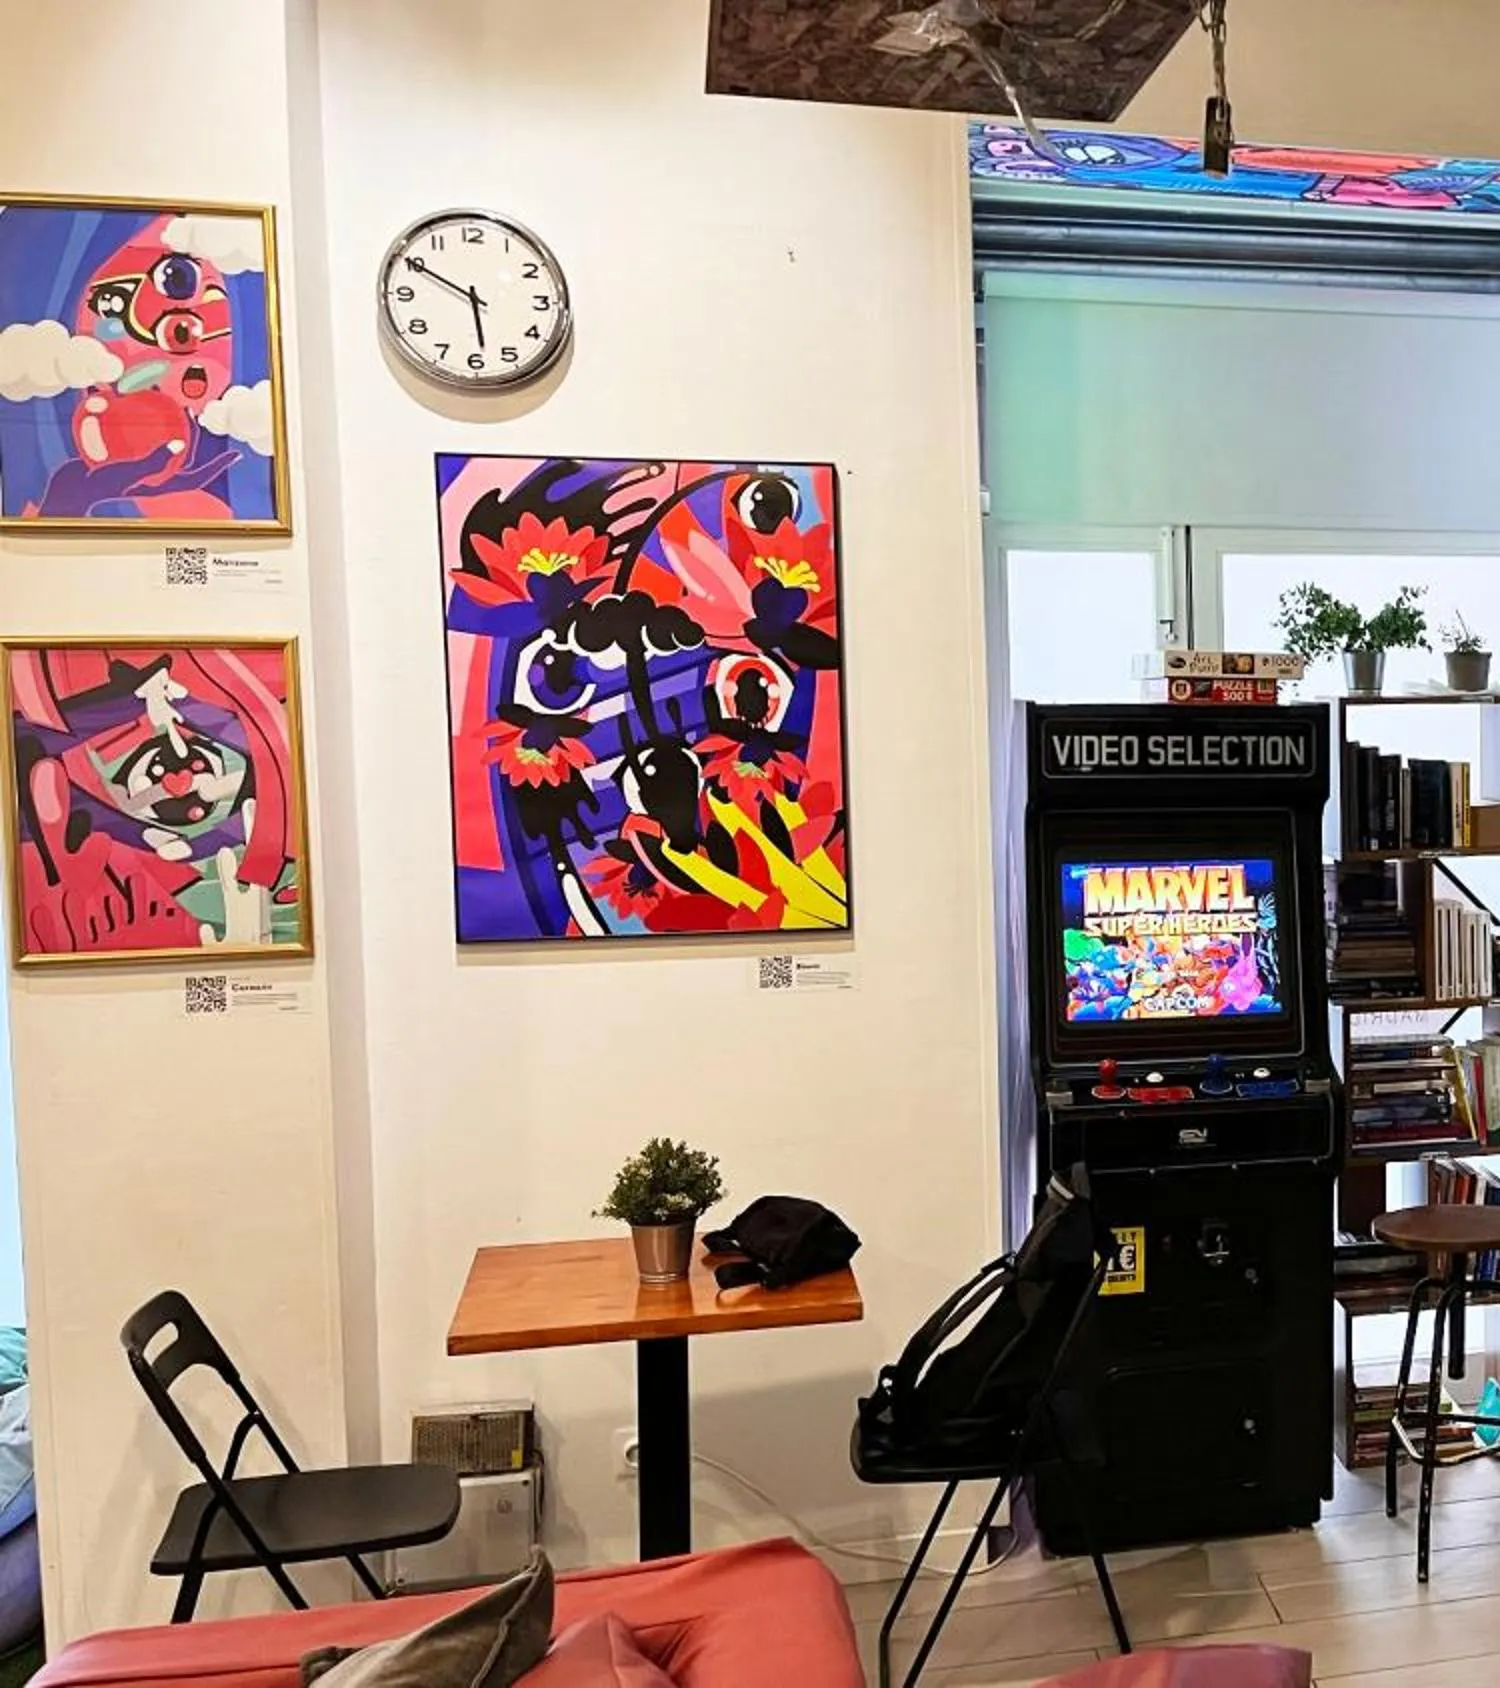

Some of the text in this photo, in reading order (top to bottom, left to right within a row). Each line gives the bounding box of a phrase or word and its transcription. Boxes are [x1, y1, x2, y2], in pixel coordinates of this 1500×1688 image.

[431, 235, 444, 251] 11
[462, 227, 484, 244] 12
[404, 256, 425, 273] 10
[522, 263, 539, 279] 2
[396, 286, 415, 302] 9
[532, 295, 550, 311] 3
[408, 319, 428, 335] 8
[524, 325, 541, 340] 4
[434, 344, 450, 360] 7
[501, 347, 519, 362] 5
[467, 354, 485, 370] 6
[1213, 680, 1254, 691] PUZZLE
[1052, 735, 1305, 766] VIDEO SELECTION
[1084, 865, 1255, 914] MARVEL
[1084, 911, 1258, 936] SUPER HEROES
[1144, 996, 1213, 1012] CAPCOM
